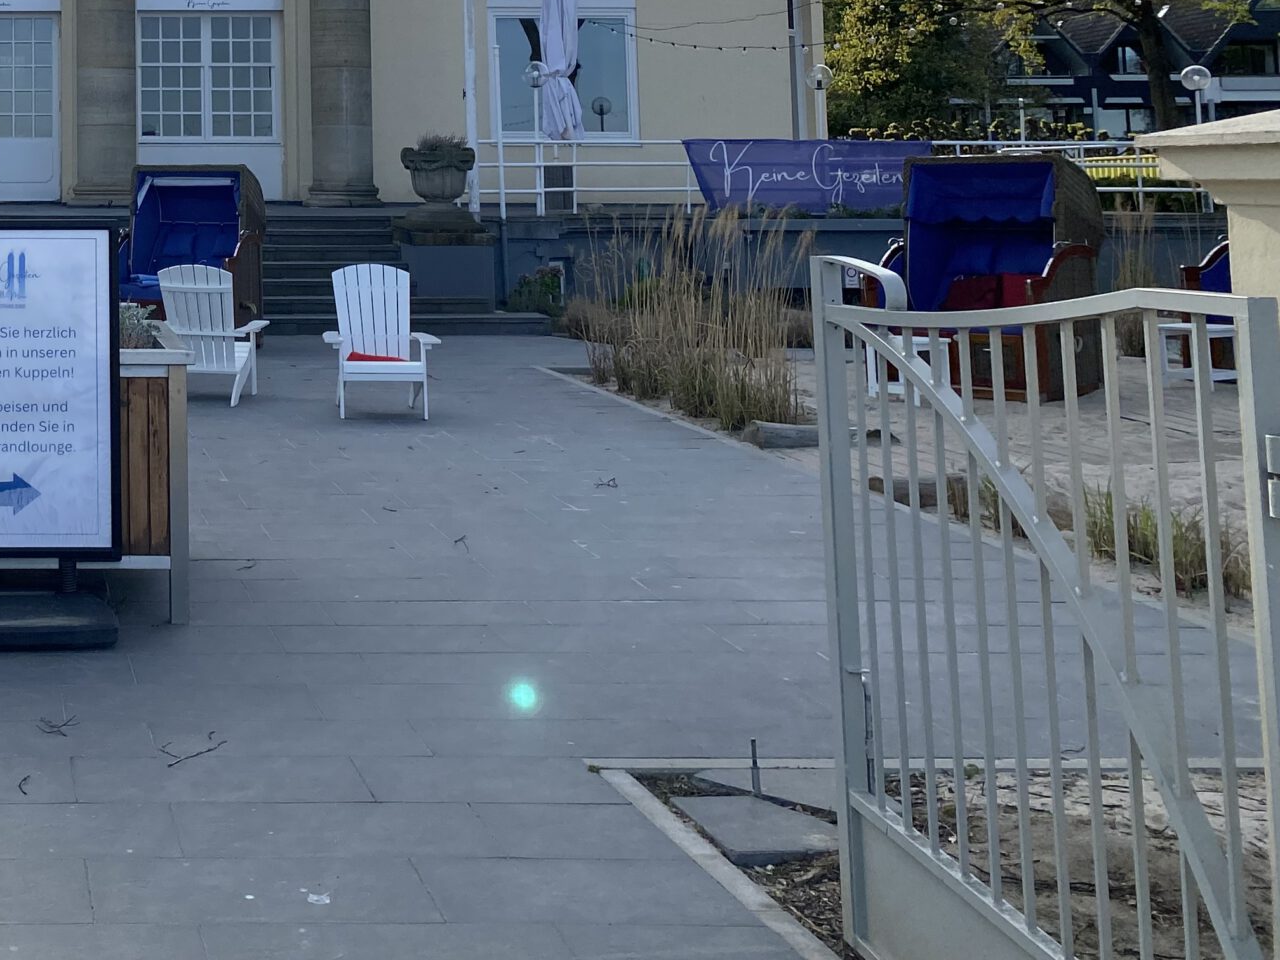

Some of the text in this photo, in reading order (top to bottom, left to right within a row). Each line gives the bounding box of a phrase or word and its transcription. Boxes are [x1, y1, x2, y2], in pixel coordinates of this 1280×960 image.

[709, 140, 904, 205] Keine Gezeiten
[0, 326, 20, 339] Sie
[23, 326, 77, 339] herzlich
[5, 346, 18, 359] in
[21, 347, 76, 359] unseren
[14, 366, 74, 382] Kuppeln!
[42, 400, 68, 413] und
[38, 420, 59, 433] Sie
[62, 420, 75, 433] in
